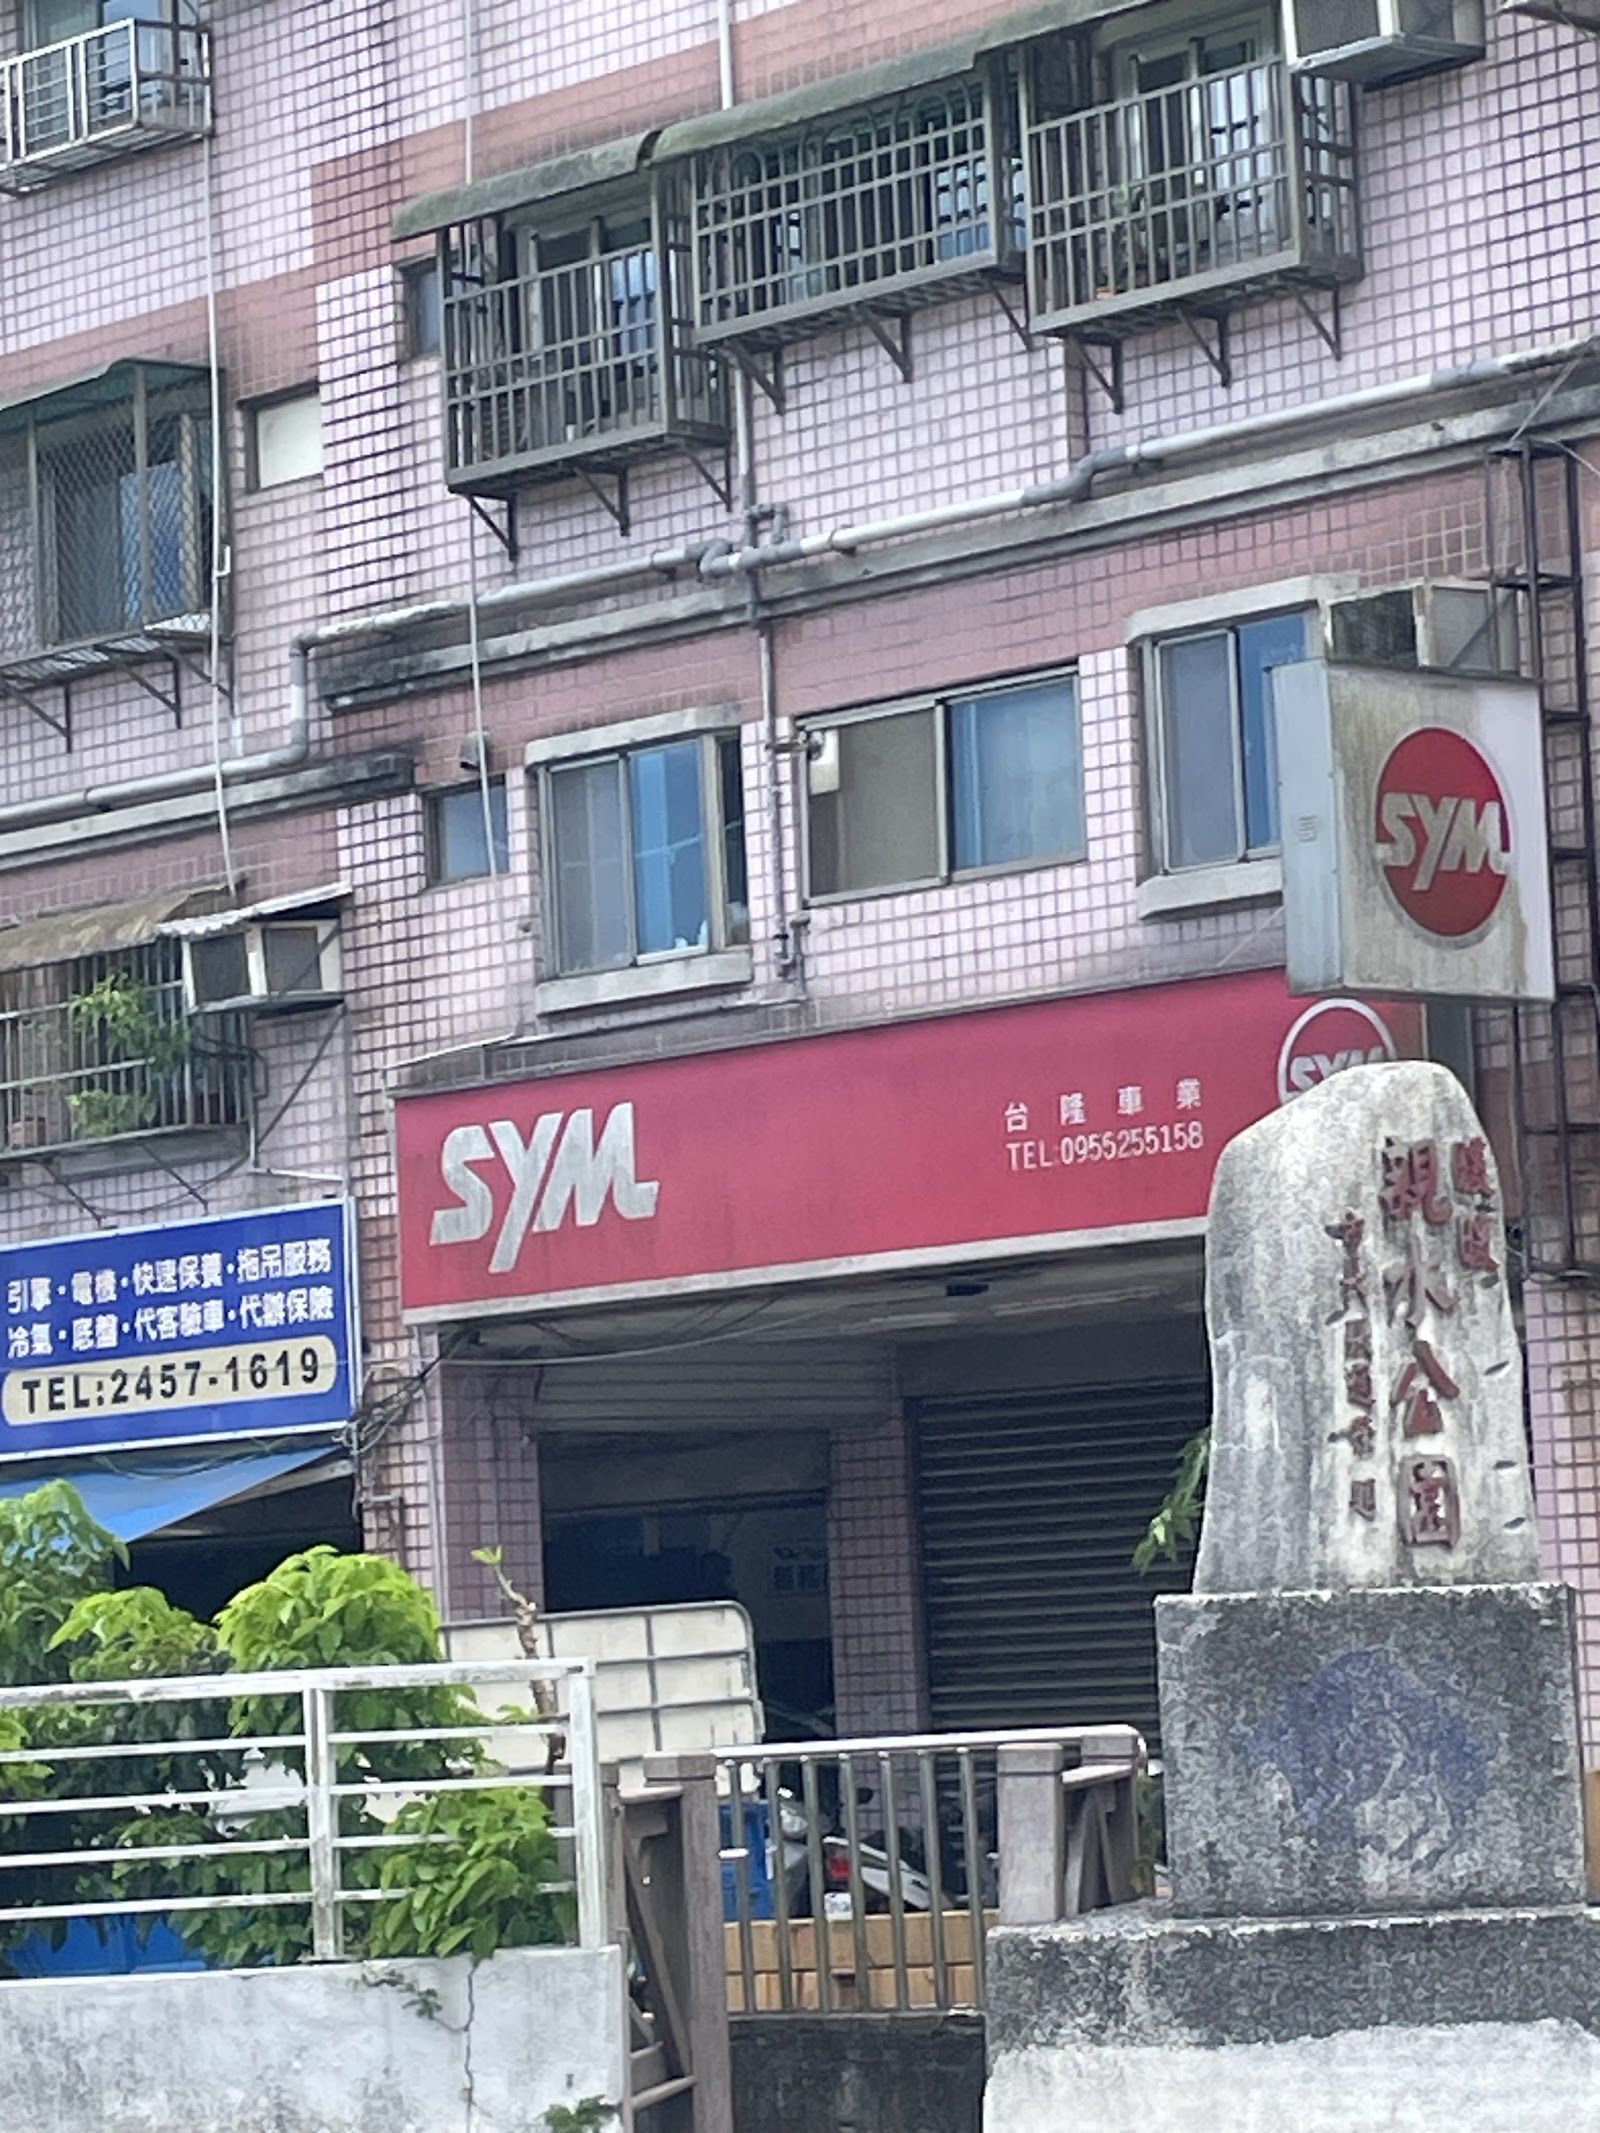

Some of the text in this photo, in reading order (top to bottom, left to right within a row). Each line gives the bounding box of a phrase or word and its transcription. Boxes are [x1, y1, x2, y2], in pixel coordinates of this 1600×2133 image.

[1374, 791, 1511, 892] SYM
[1004, 1078, 1202, 1133] 台隆車業
[429, 1102, 660, 1274] SYM
[1379, 1137, 1463, 1548] 親水公園
